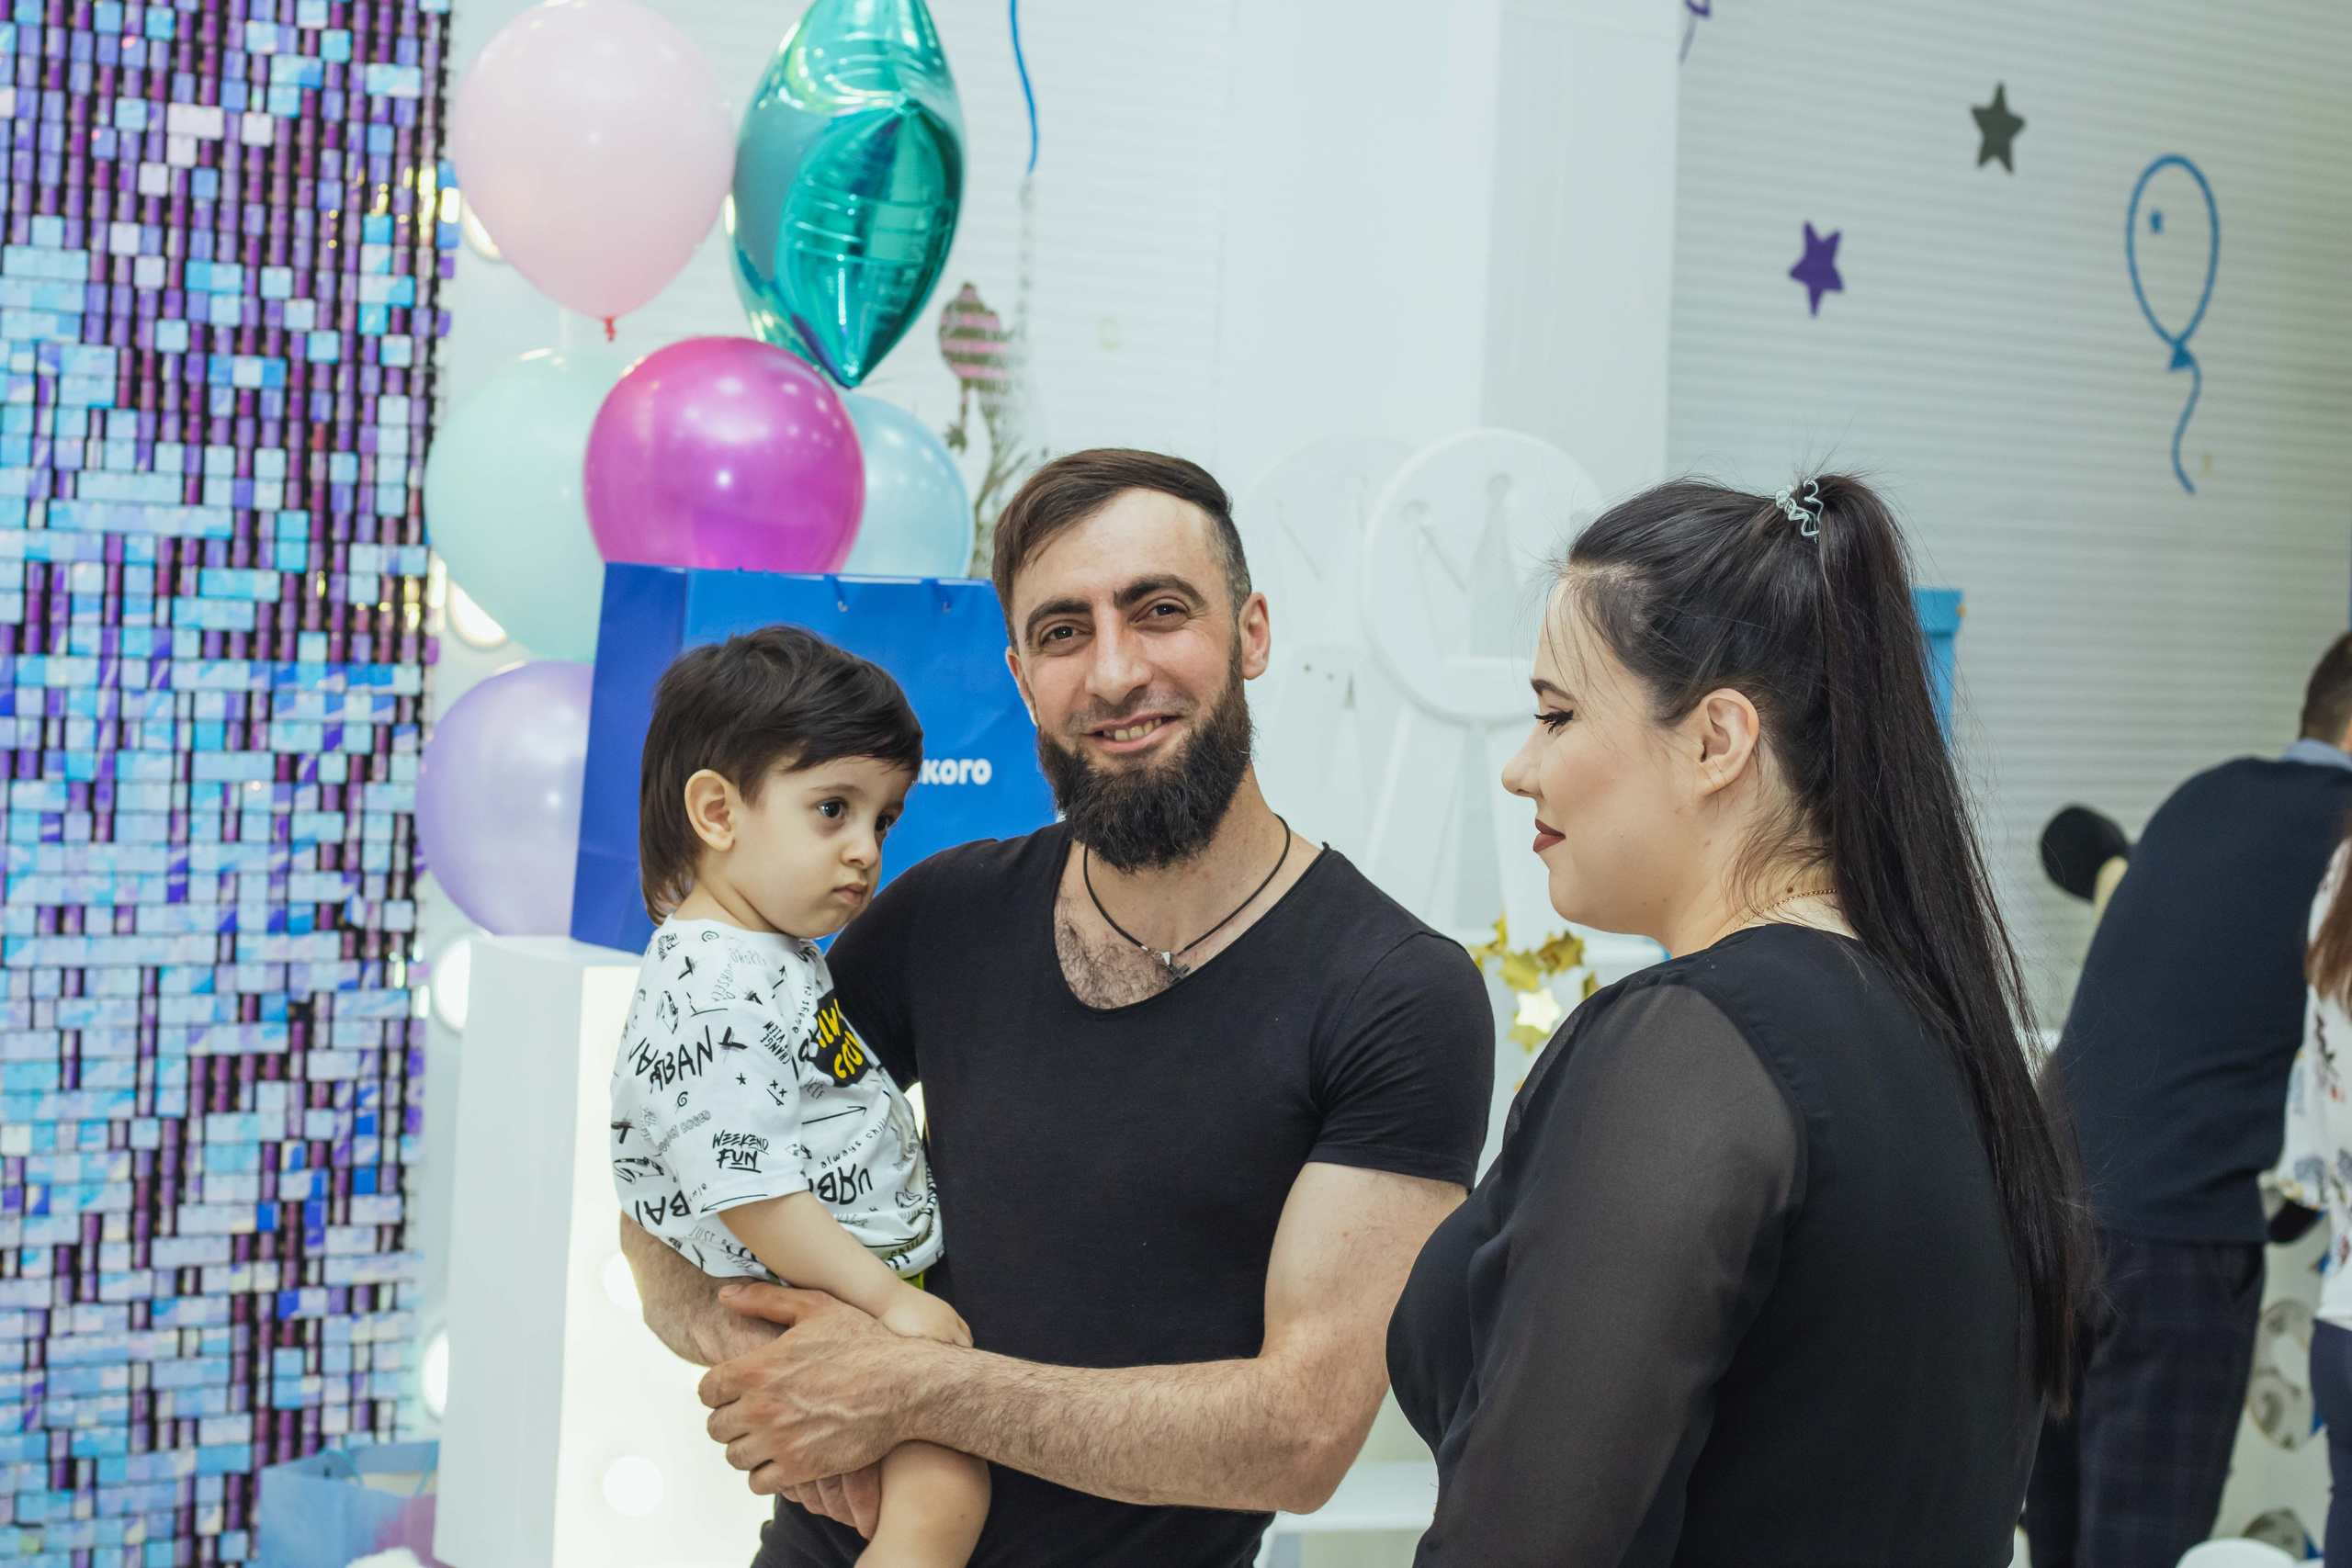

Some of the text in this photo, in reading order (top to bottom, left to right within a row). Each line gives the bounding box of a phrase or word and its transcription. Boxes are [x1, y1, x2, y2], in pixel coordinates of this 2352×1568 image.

[918, 758, 992, 785] кого
[712, 1130, 769, 1152] WEEKEND
[820, 1140, 862, 1169] always
[717, 1148, 758, 1170] FUN
[808, 1163, 873, 1205] URB
